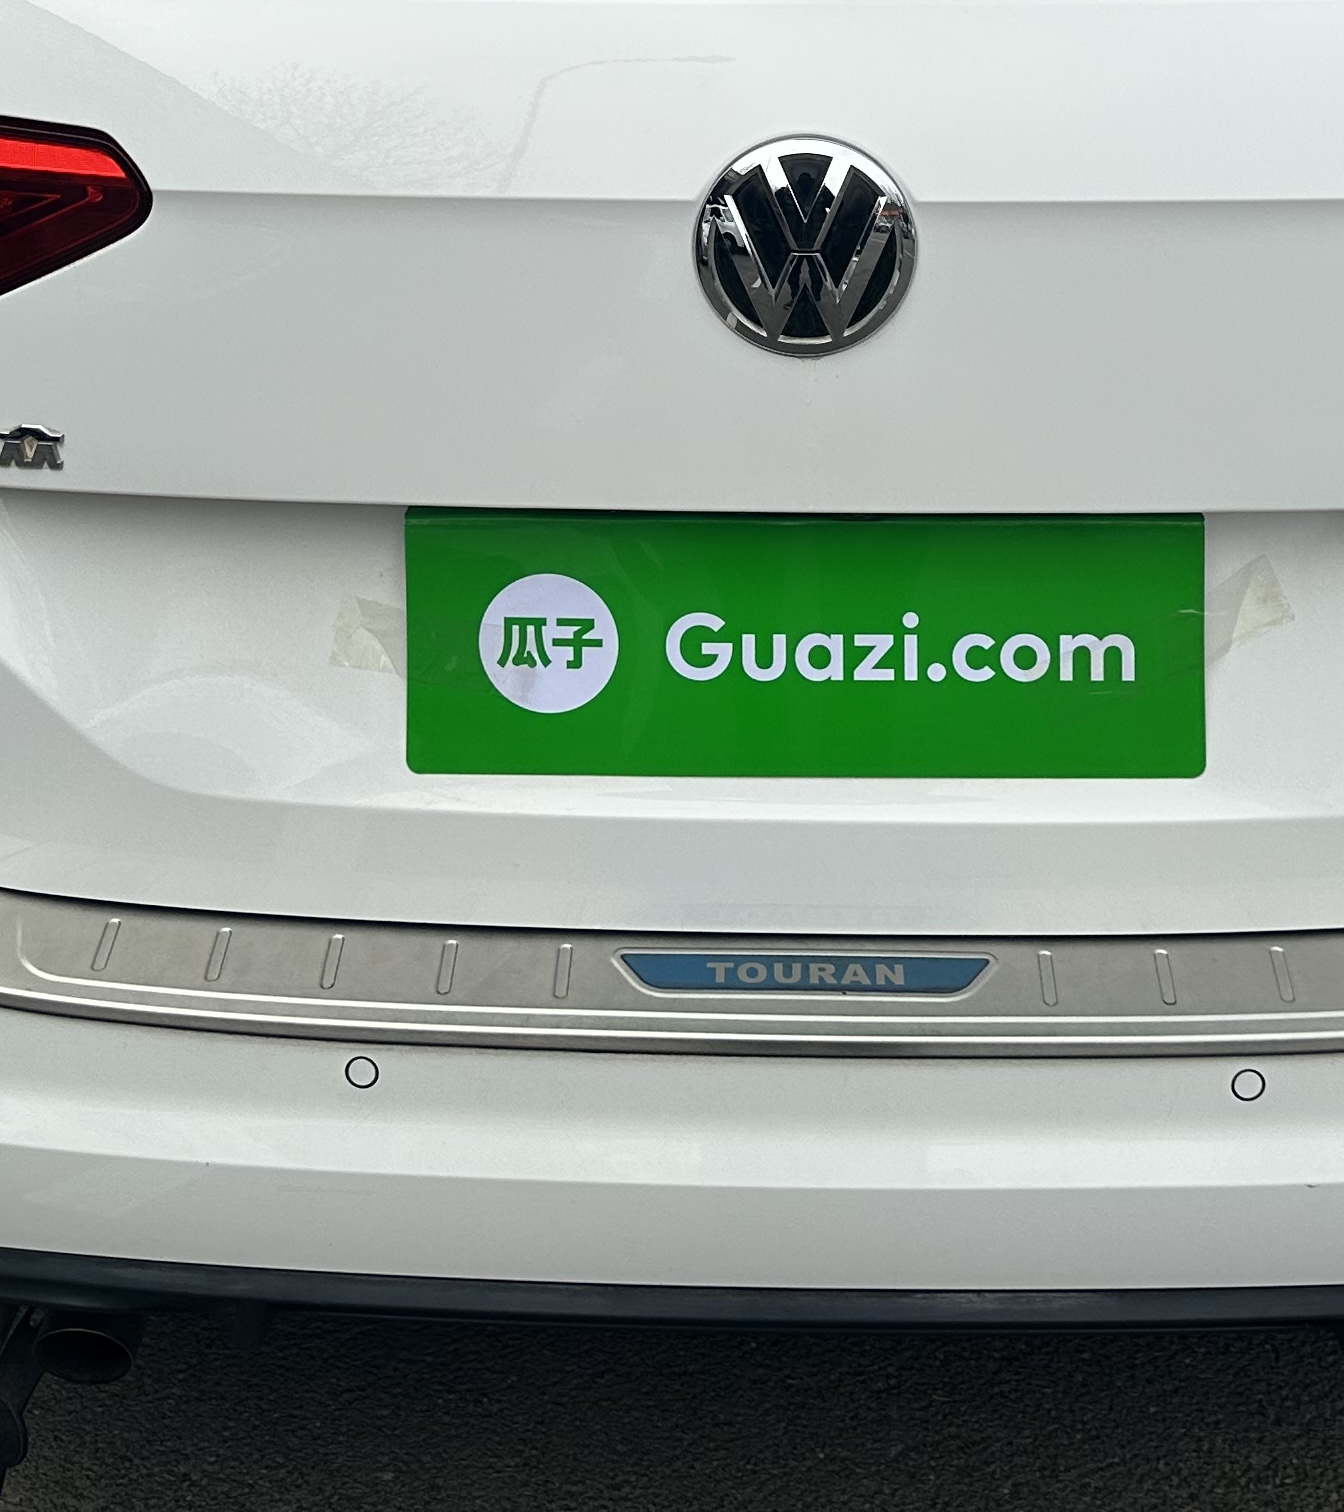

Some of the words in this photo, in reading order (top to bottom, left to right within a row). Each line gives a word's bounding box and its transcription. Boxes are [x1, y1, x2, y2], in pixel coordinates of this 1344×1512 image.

[497, 615, 604, 670] 瓜子
[664, 611, 1136, 683] Guazi.com
[706, 961, 905, 986] TOURAN
